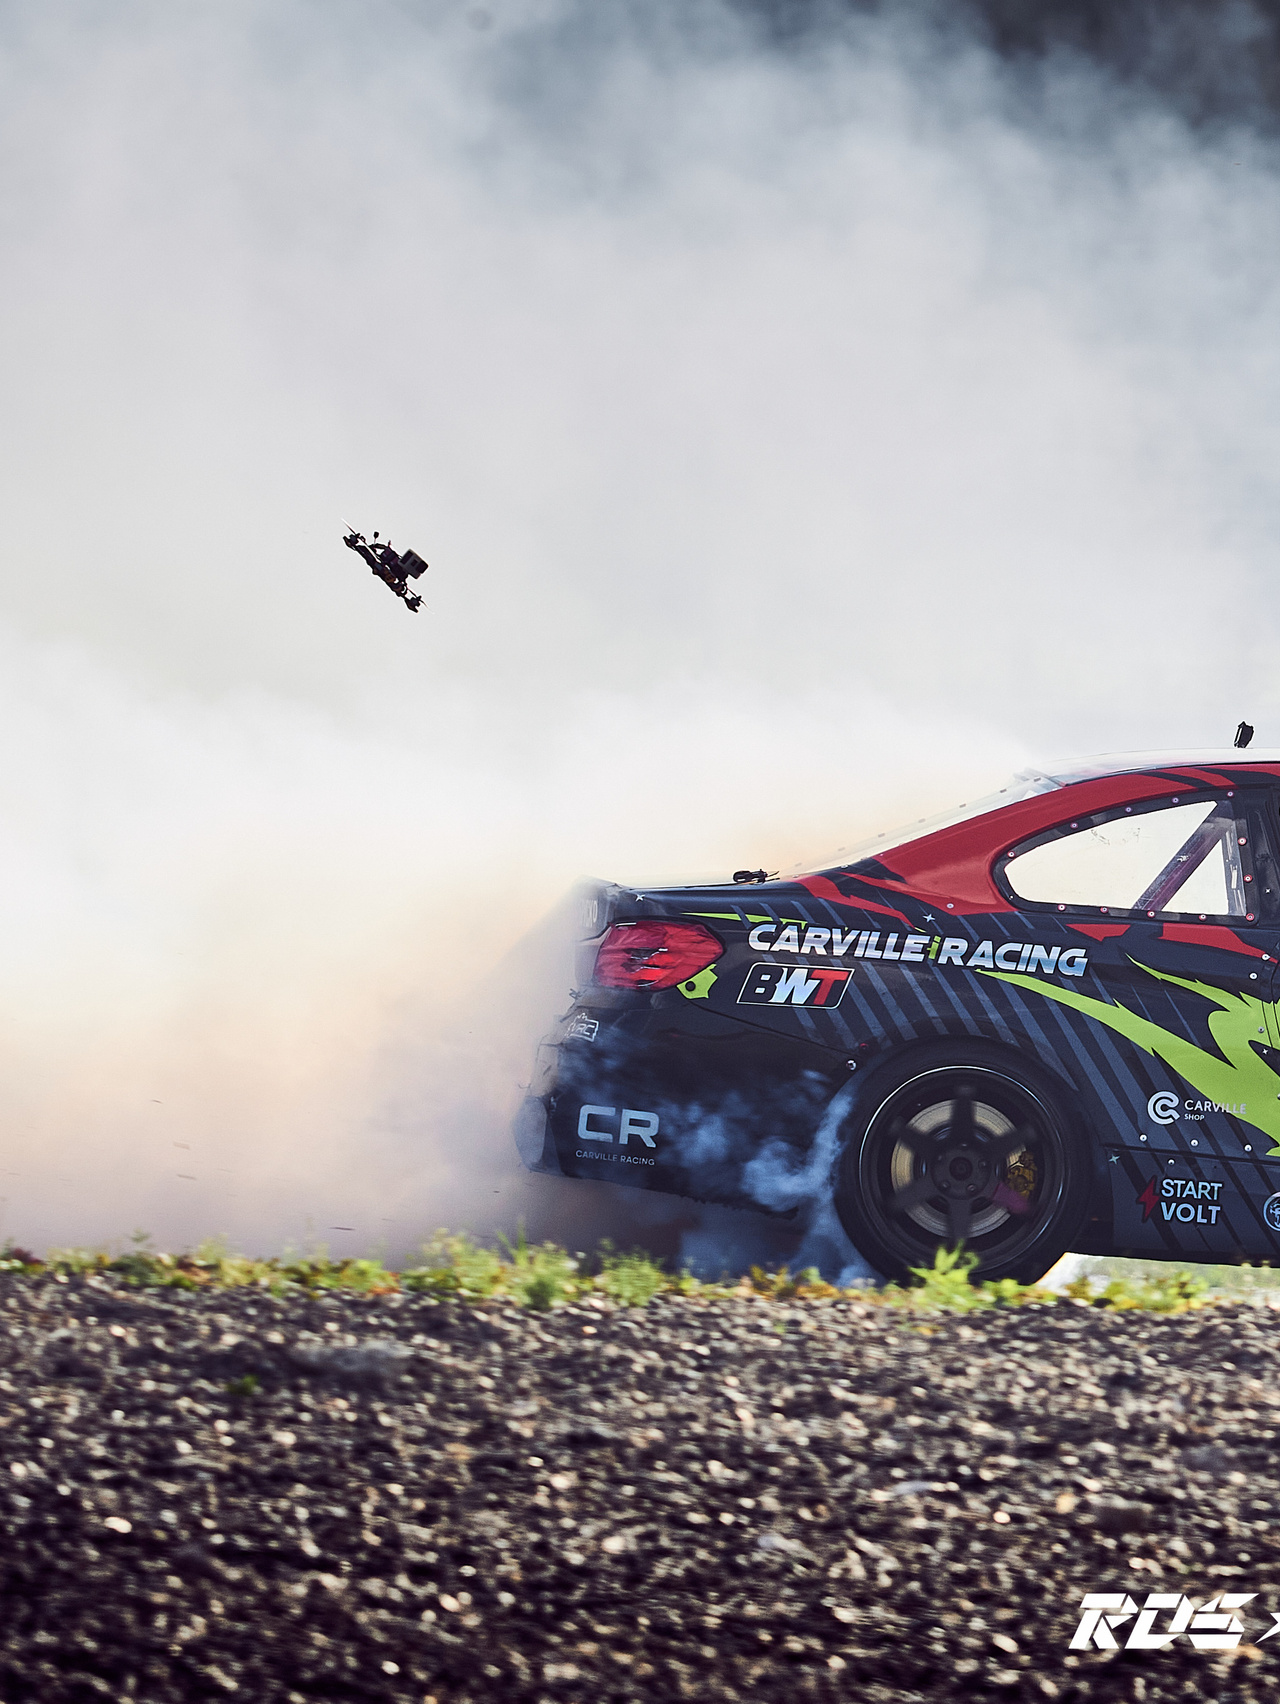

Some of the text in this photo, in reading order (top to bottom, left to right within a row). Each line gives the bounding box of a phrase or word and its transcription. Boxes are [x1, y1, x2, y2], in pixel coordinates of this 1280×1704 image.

[748, 924, 930, 963] CARVILLE
[937, 937, 1089, 977] RACING
[751, 967, 849, 1006] BWT
[1184, 1099, 1248, 1115] CARVILLE
[1184, 1113, 1205, 1122] SHOP
[577, 1104, 660, 1148] CR
[575, 1149, 655, 1166] CARVILLE RACING
[1160, 1178, 1223, 1201] START
[1160, 1201, 1222, 1225] VOLT
